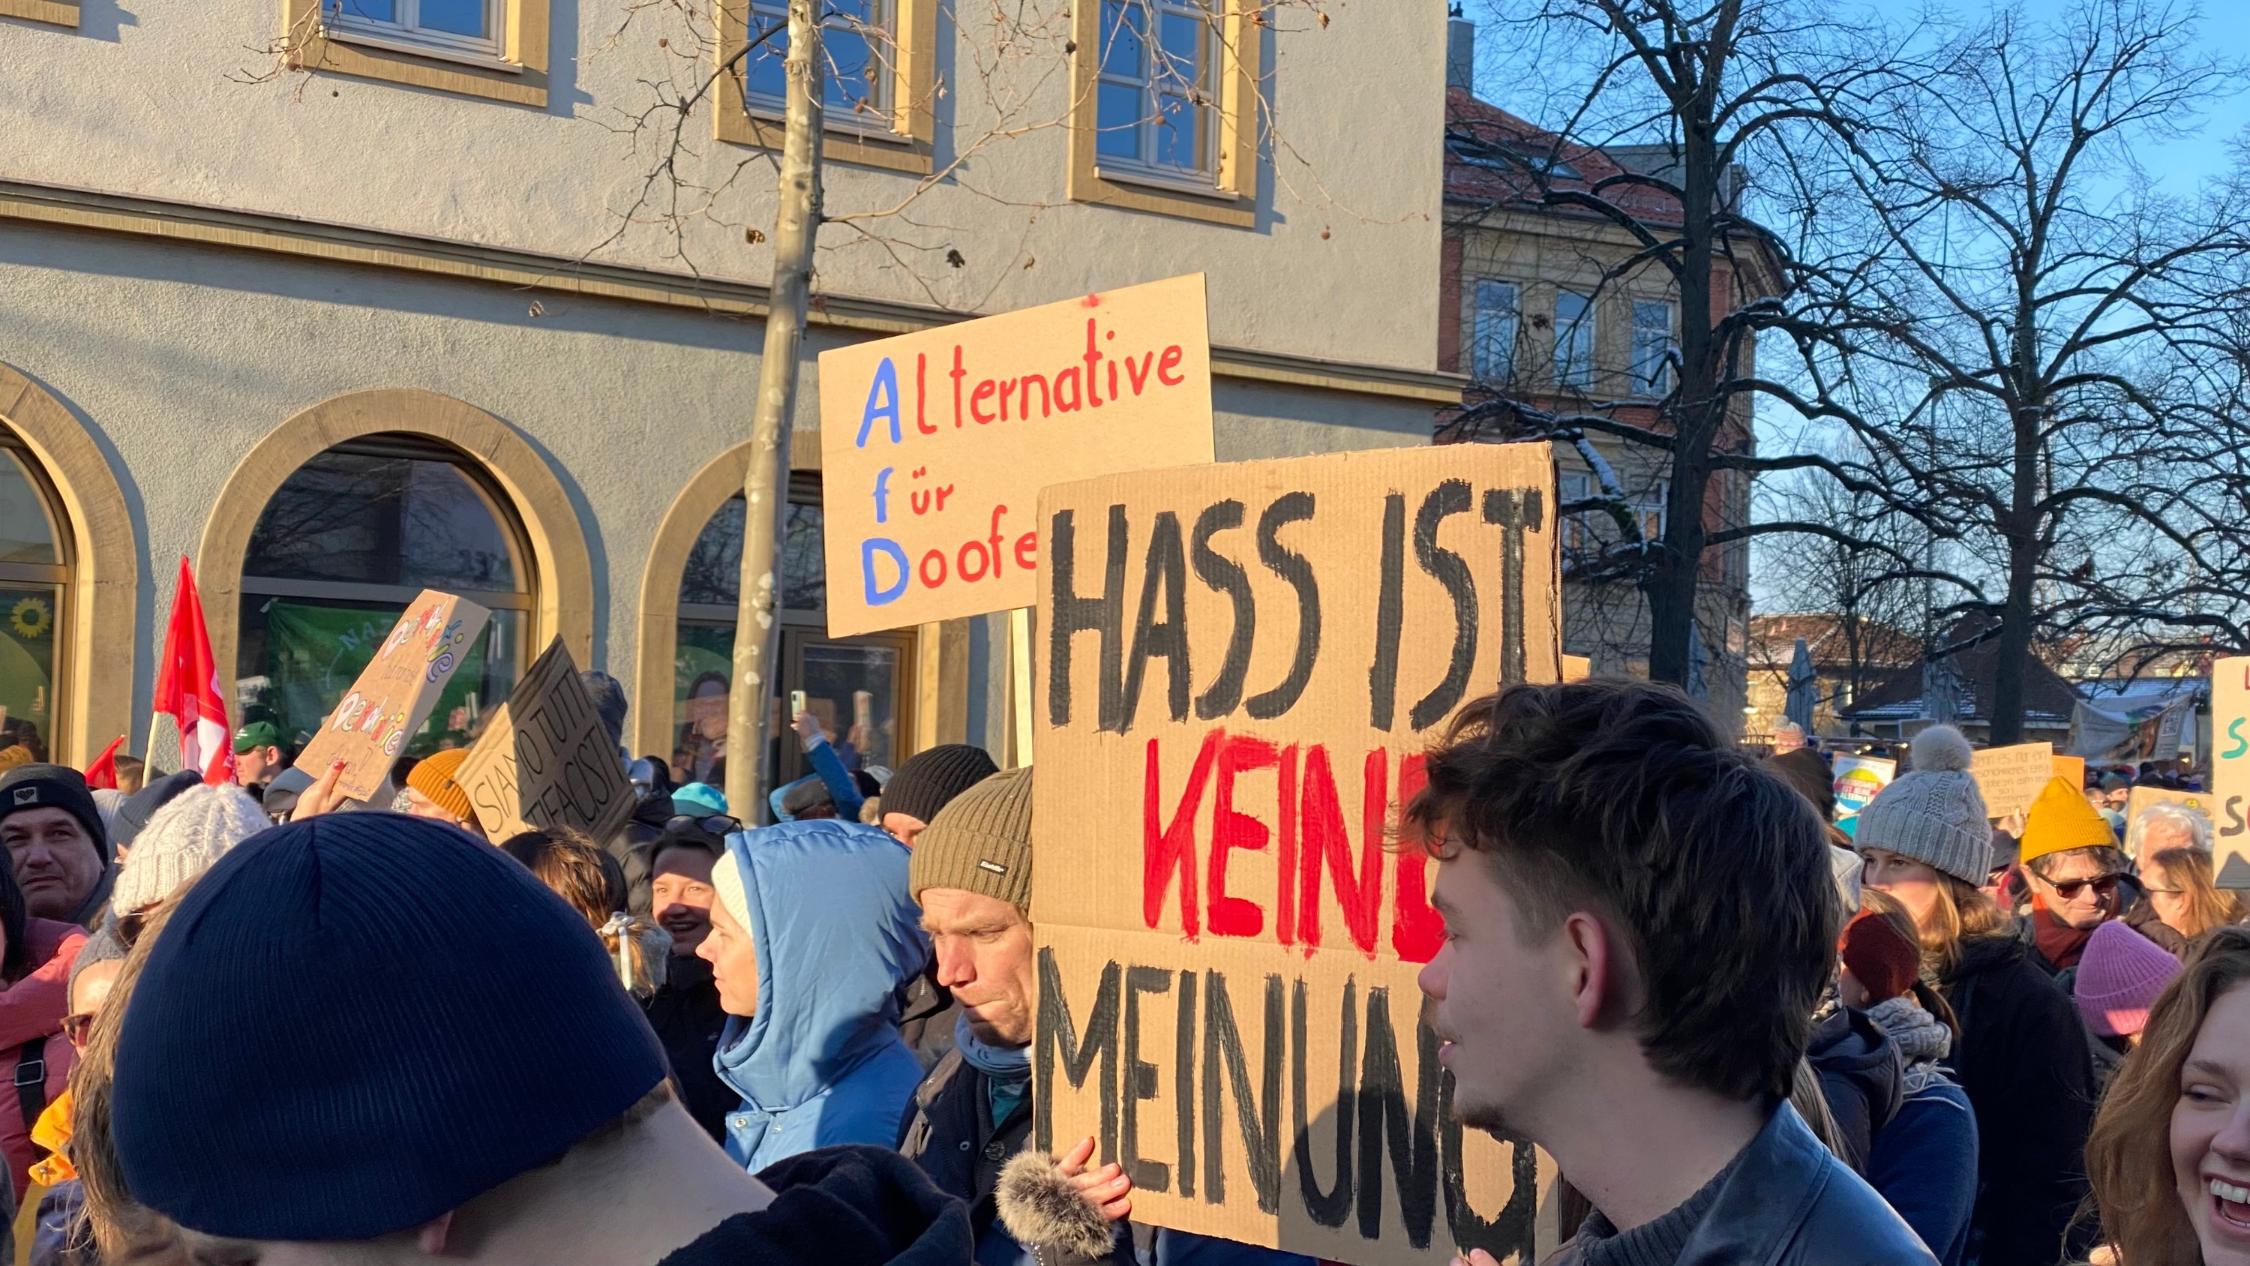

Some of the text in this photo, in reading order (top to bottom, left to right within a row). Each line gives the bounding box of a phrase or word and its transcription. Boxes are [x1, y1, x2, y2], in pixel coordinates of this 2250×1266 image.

[856, 317, 1185, 448] Alternative
[872, 465, 954, 524] für
[1049, 478, 1544, 737] HASS IST
[474, 664, 592, 834] SIAMO TUTTI
[512, 721, 625, 835] TIFACISTI
[2219, 795, 2250, 837] S
